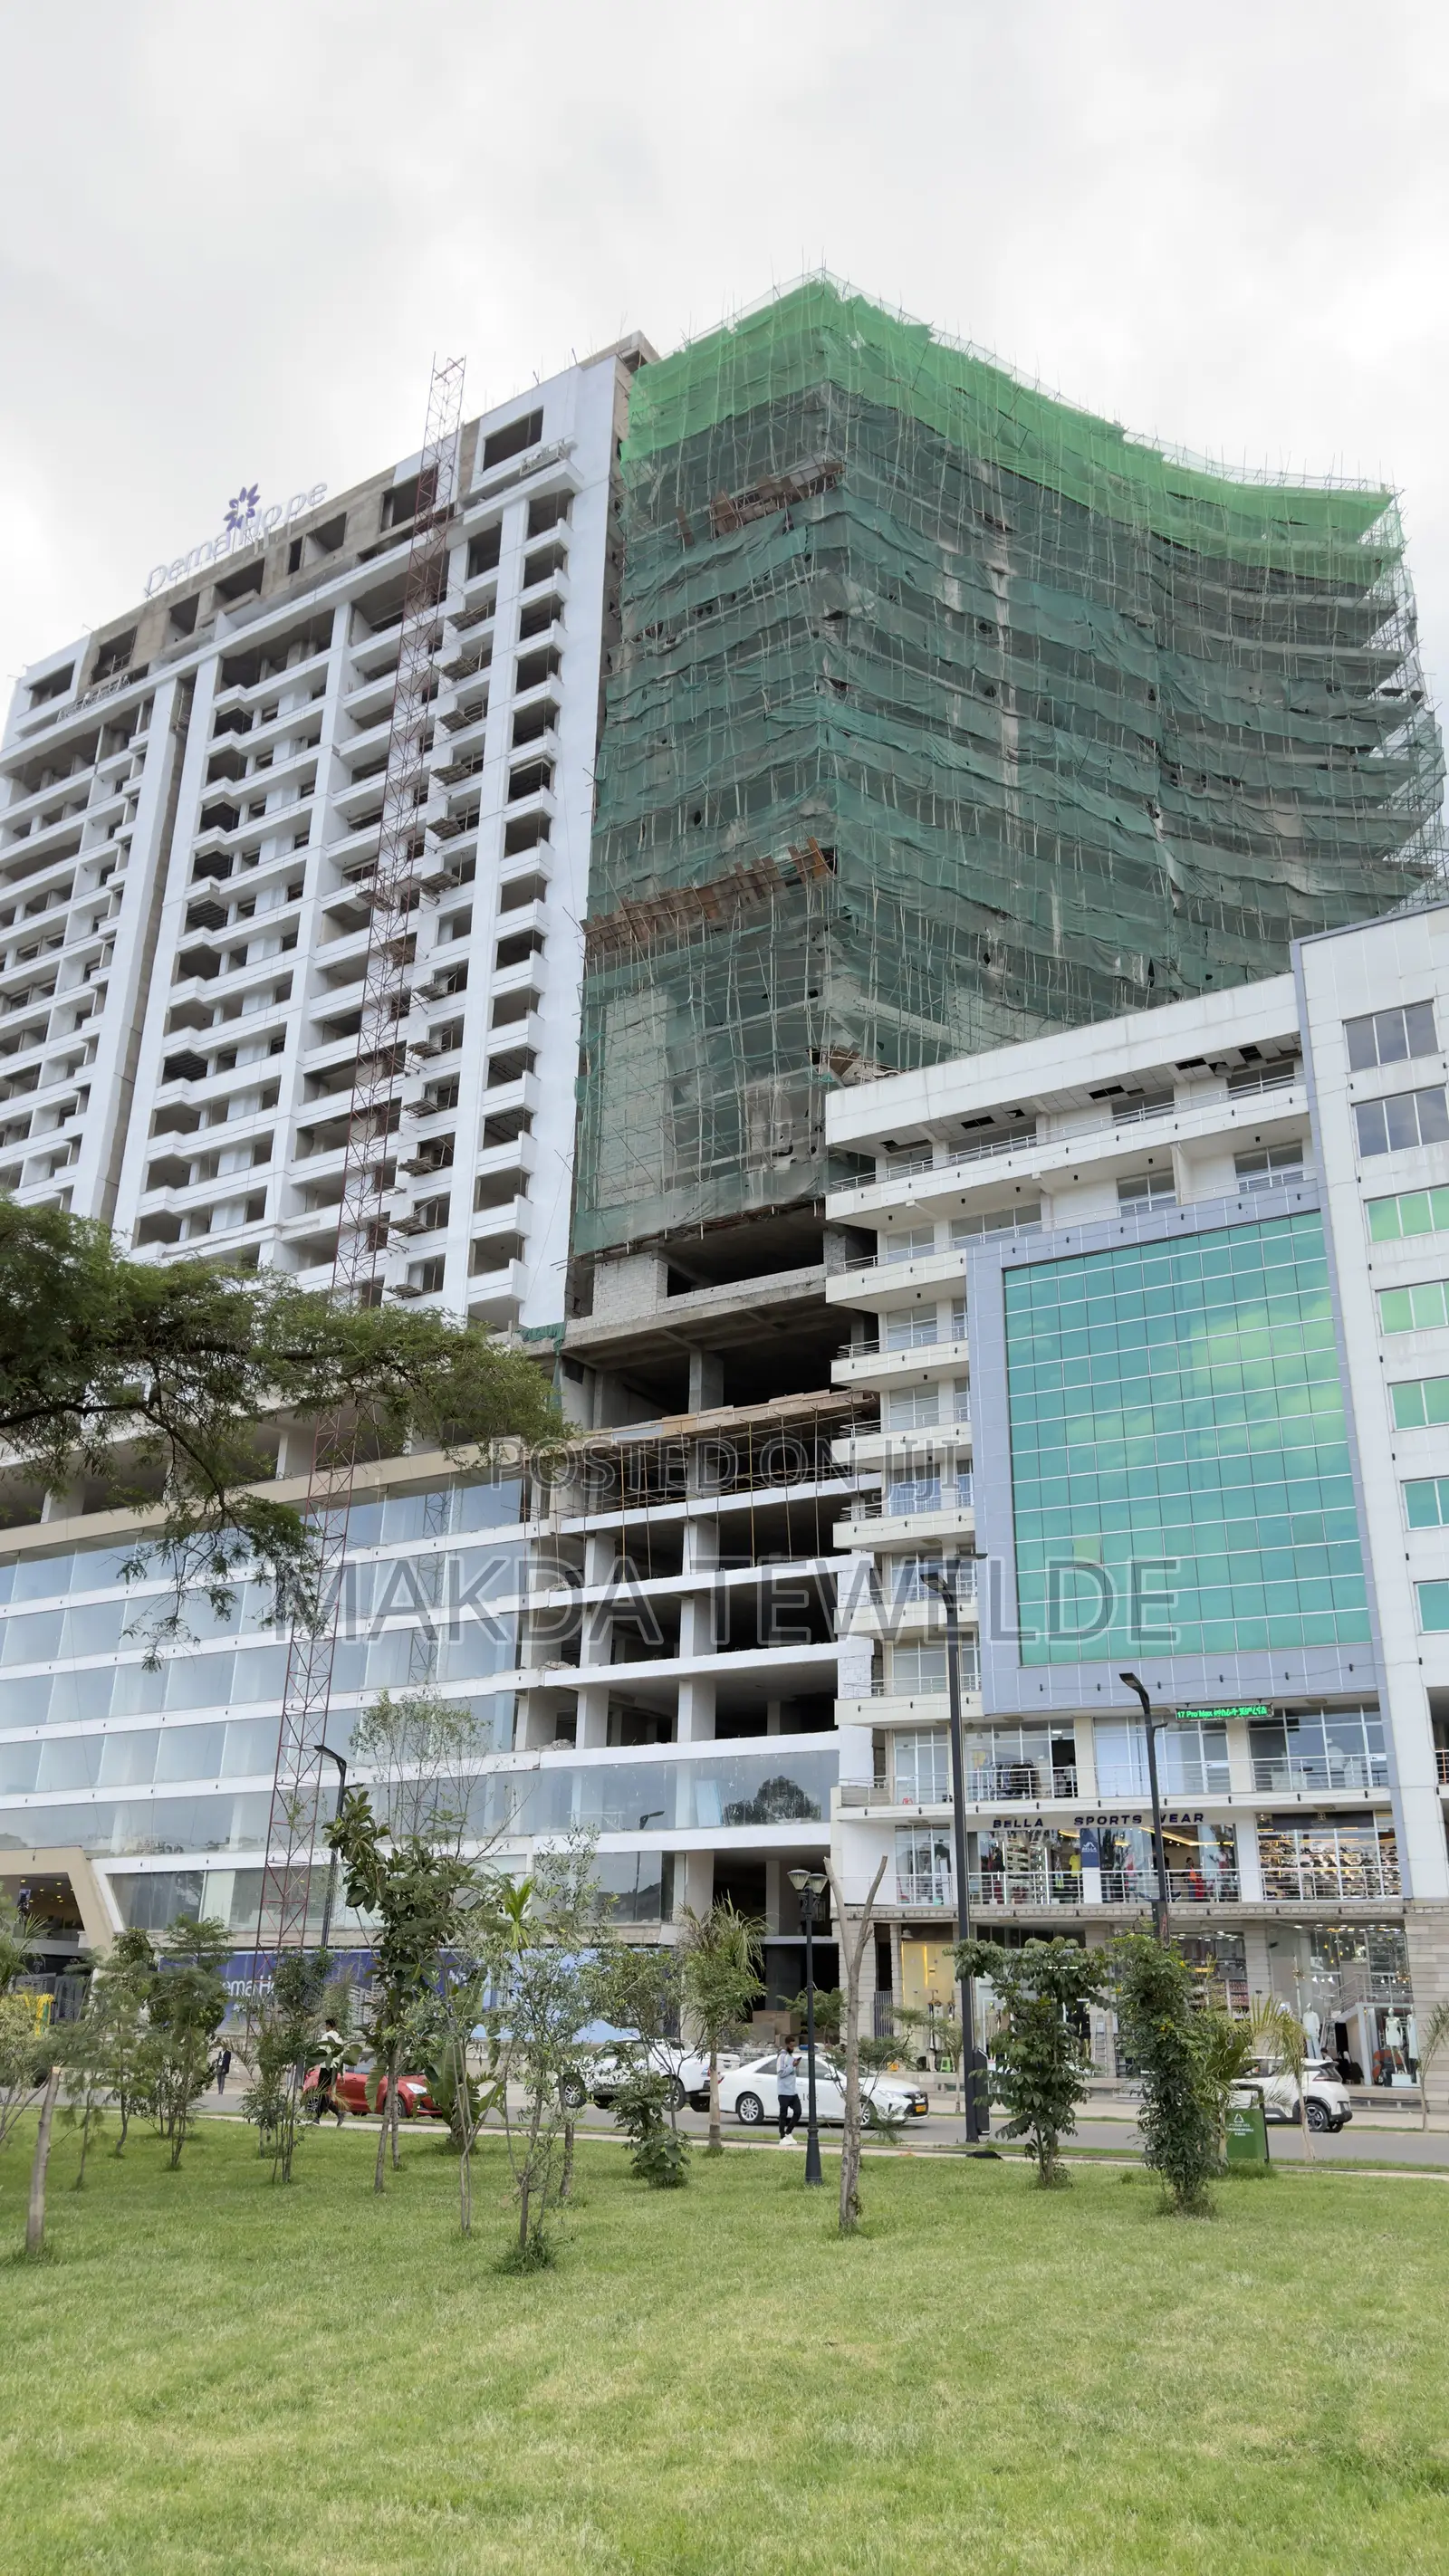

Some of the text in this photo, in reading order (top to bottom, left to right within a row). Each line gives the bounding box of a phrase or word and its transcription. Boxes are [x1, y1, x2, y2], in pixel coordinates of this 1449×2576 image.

[1177, 1710, 1185, 1719] 17
[993, 1818, 1044, 1829] BELLA
[1074, 1815, 1143, 1826] SPORTS
